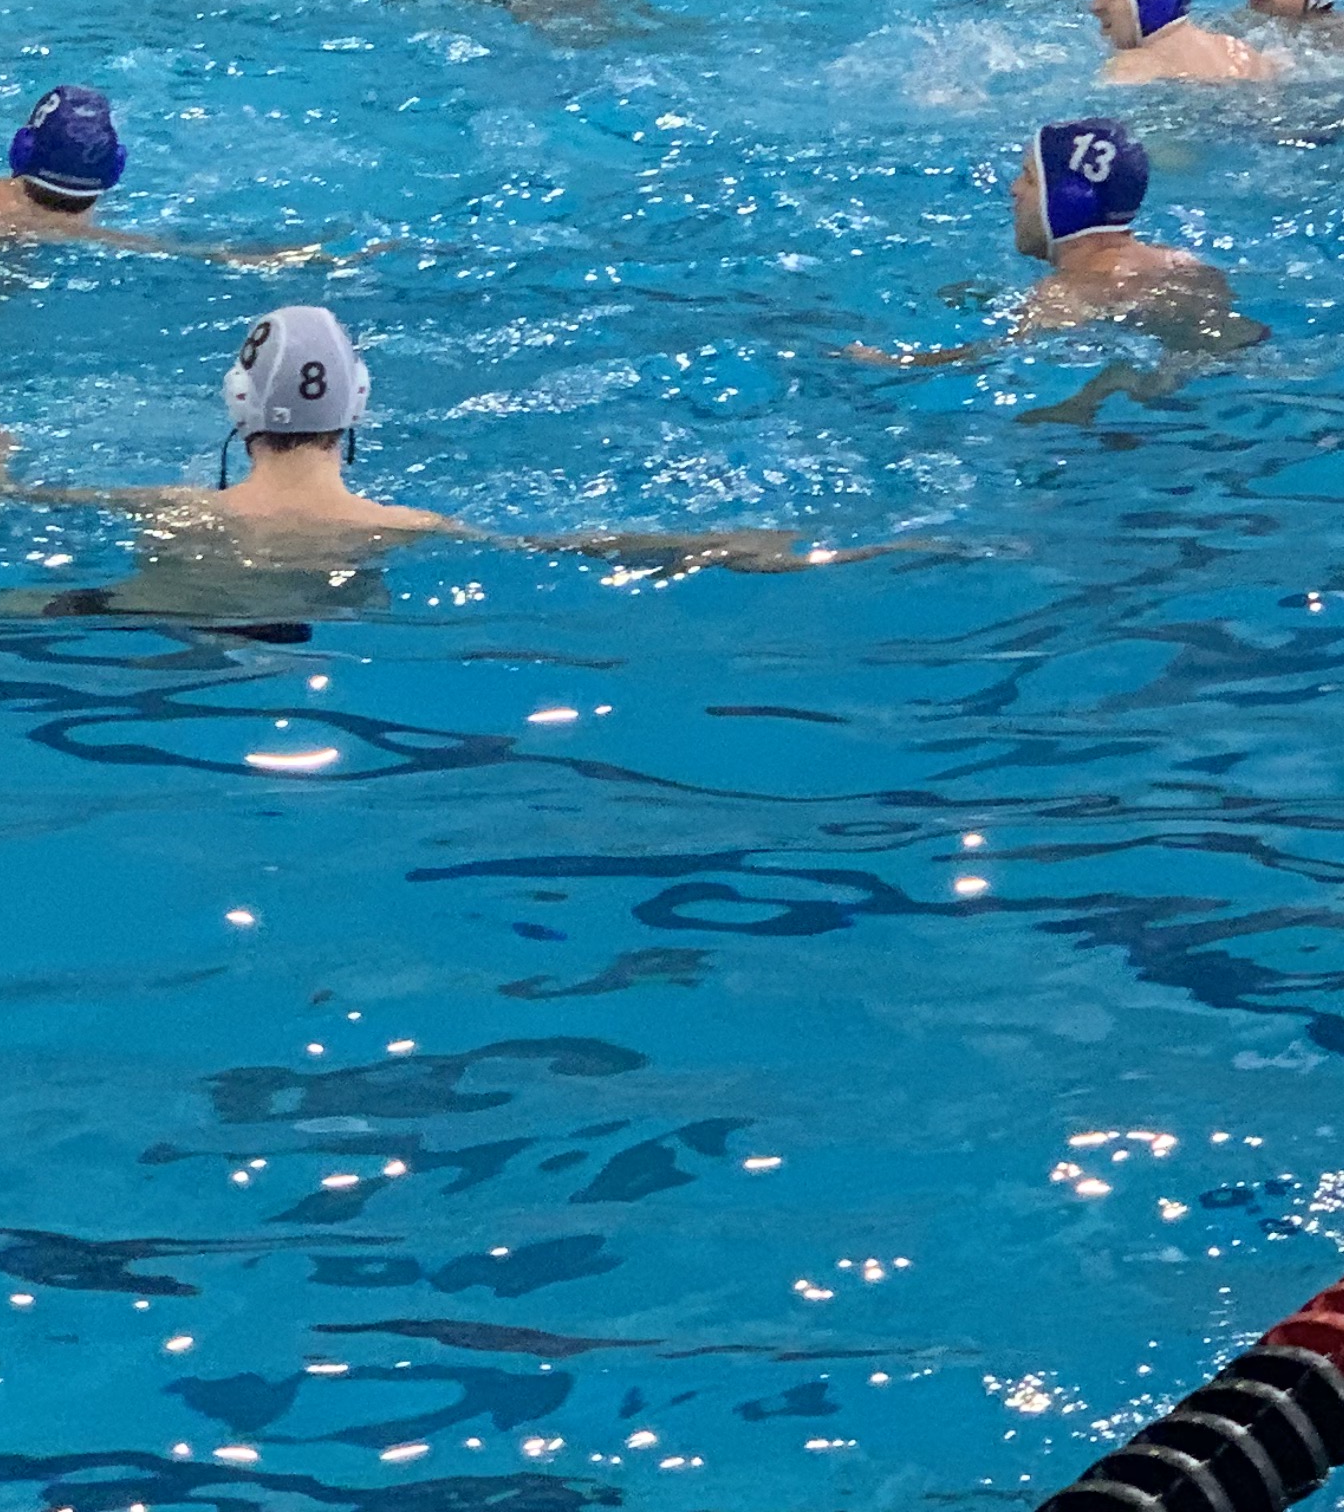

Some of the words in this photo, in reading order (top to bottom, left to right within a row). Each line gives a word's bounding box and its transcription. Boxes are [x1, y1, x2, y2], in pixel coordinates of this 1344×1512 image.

[1069, 133, 1116, 182] 13
[240, 321, 271, 371] 8
[299, 361, 328, 400] 8
